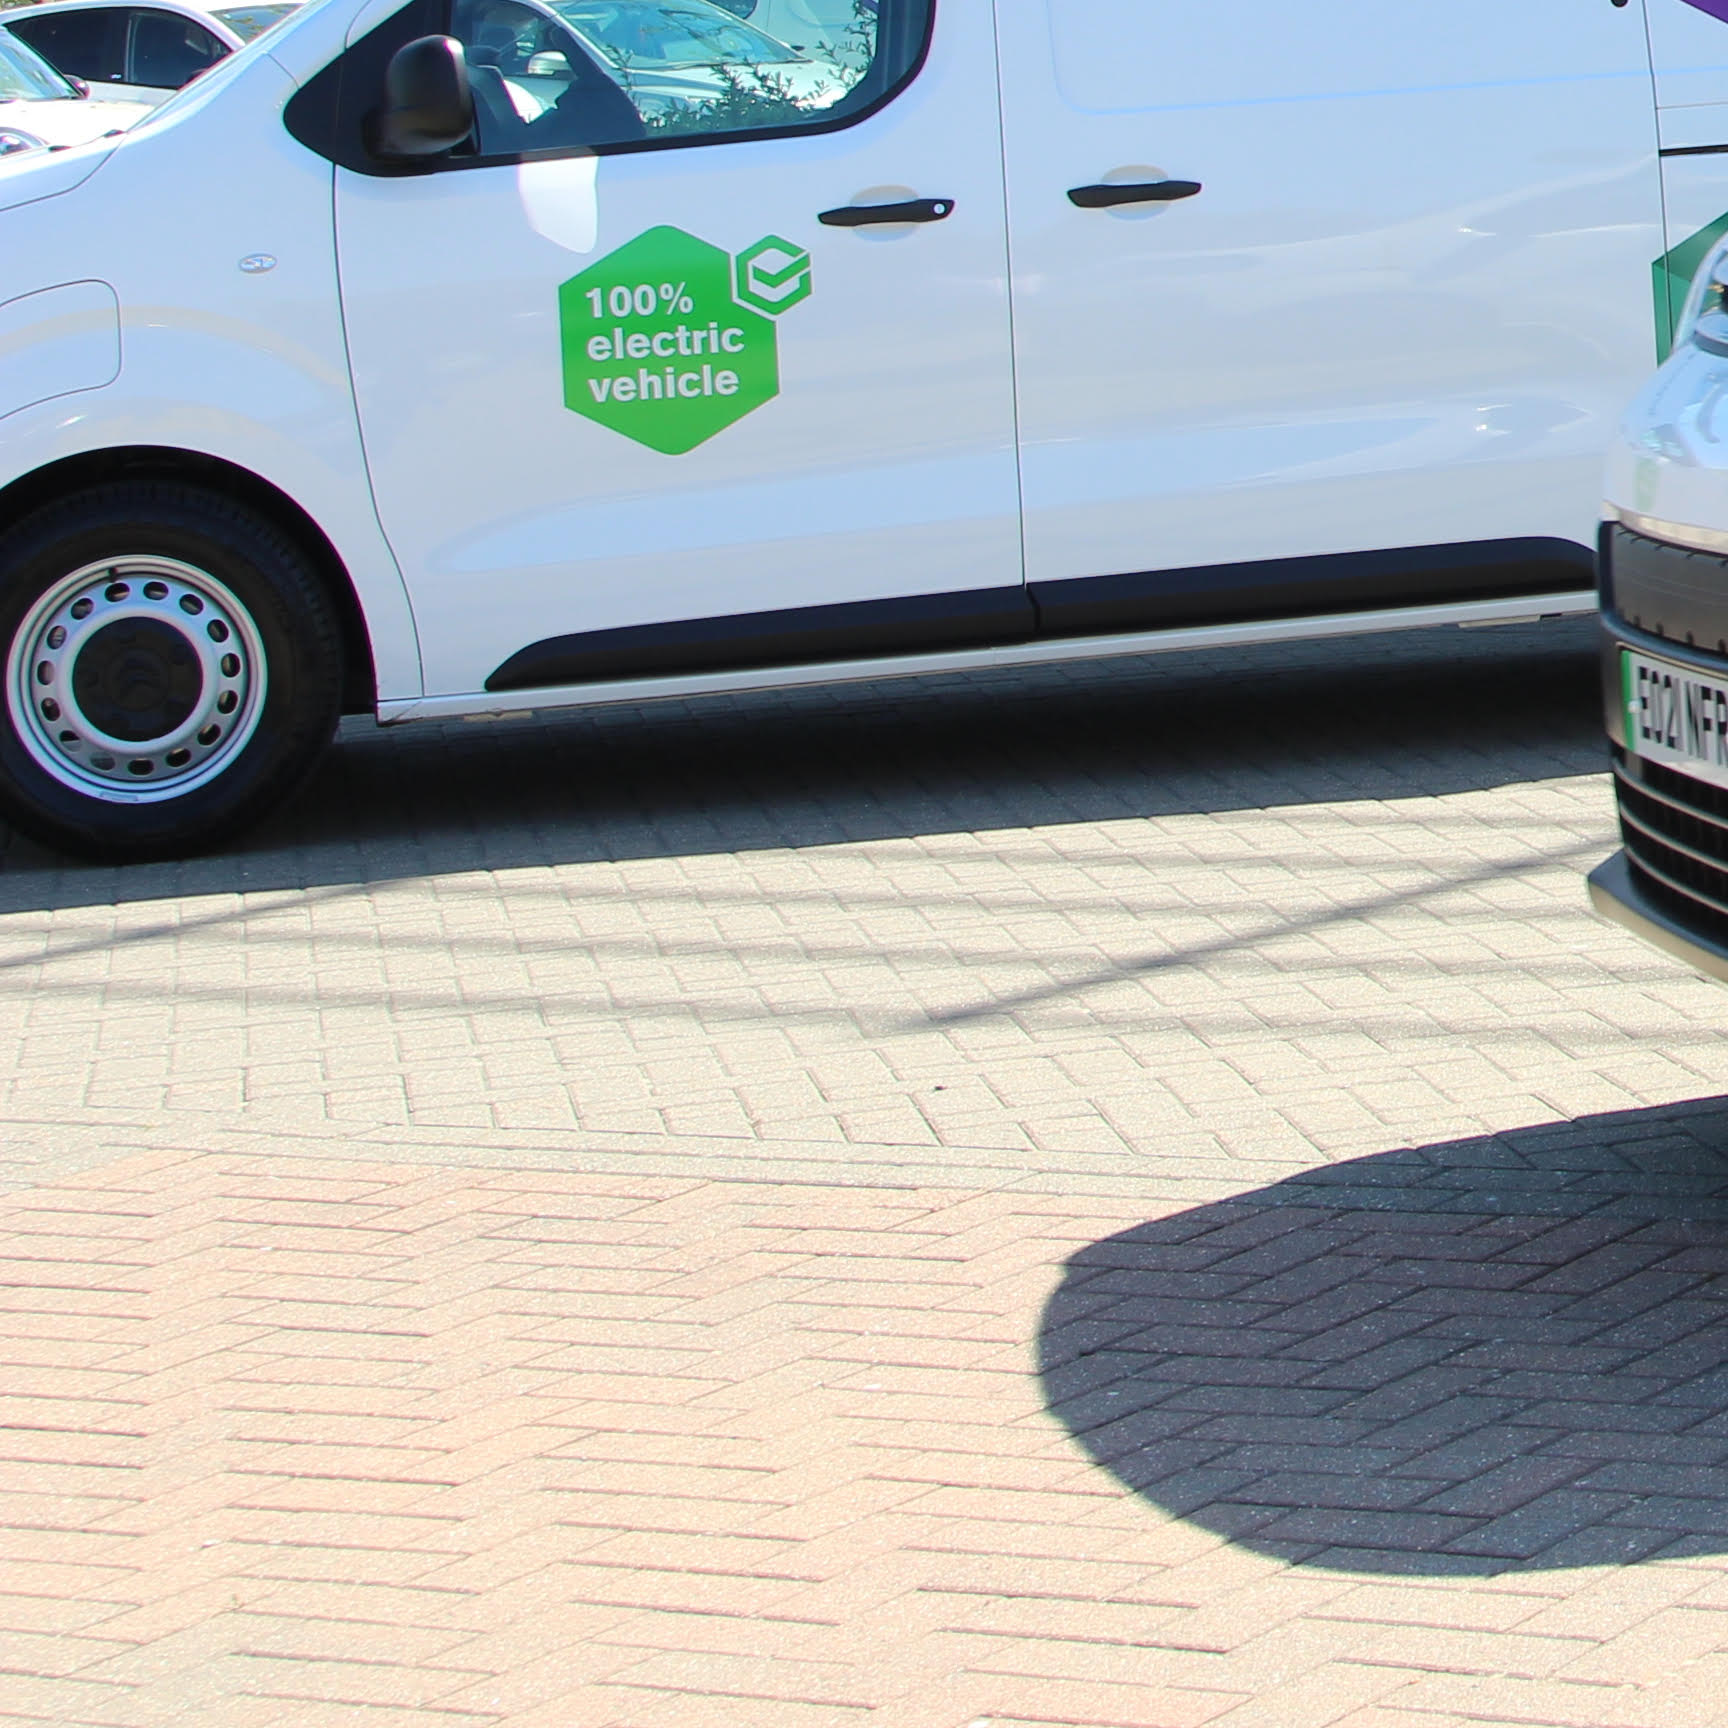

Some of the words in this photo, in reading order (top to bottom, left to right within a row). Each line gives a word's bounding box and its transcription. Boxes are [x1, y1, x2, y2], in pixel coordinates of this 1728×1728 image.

[585, 281, 694, 318] 100%
[586, 322, 745, 360] electric
[588, 364, 739, 403] vehicle
